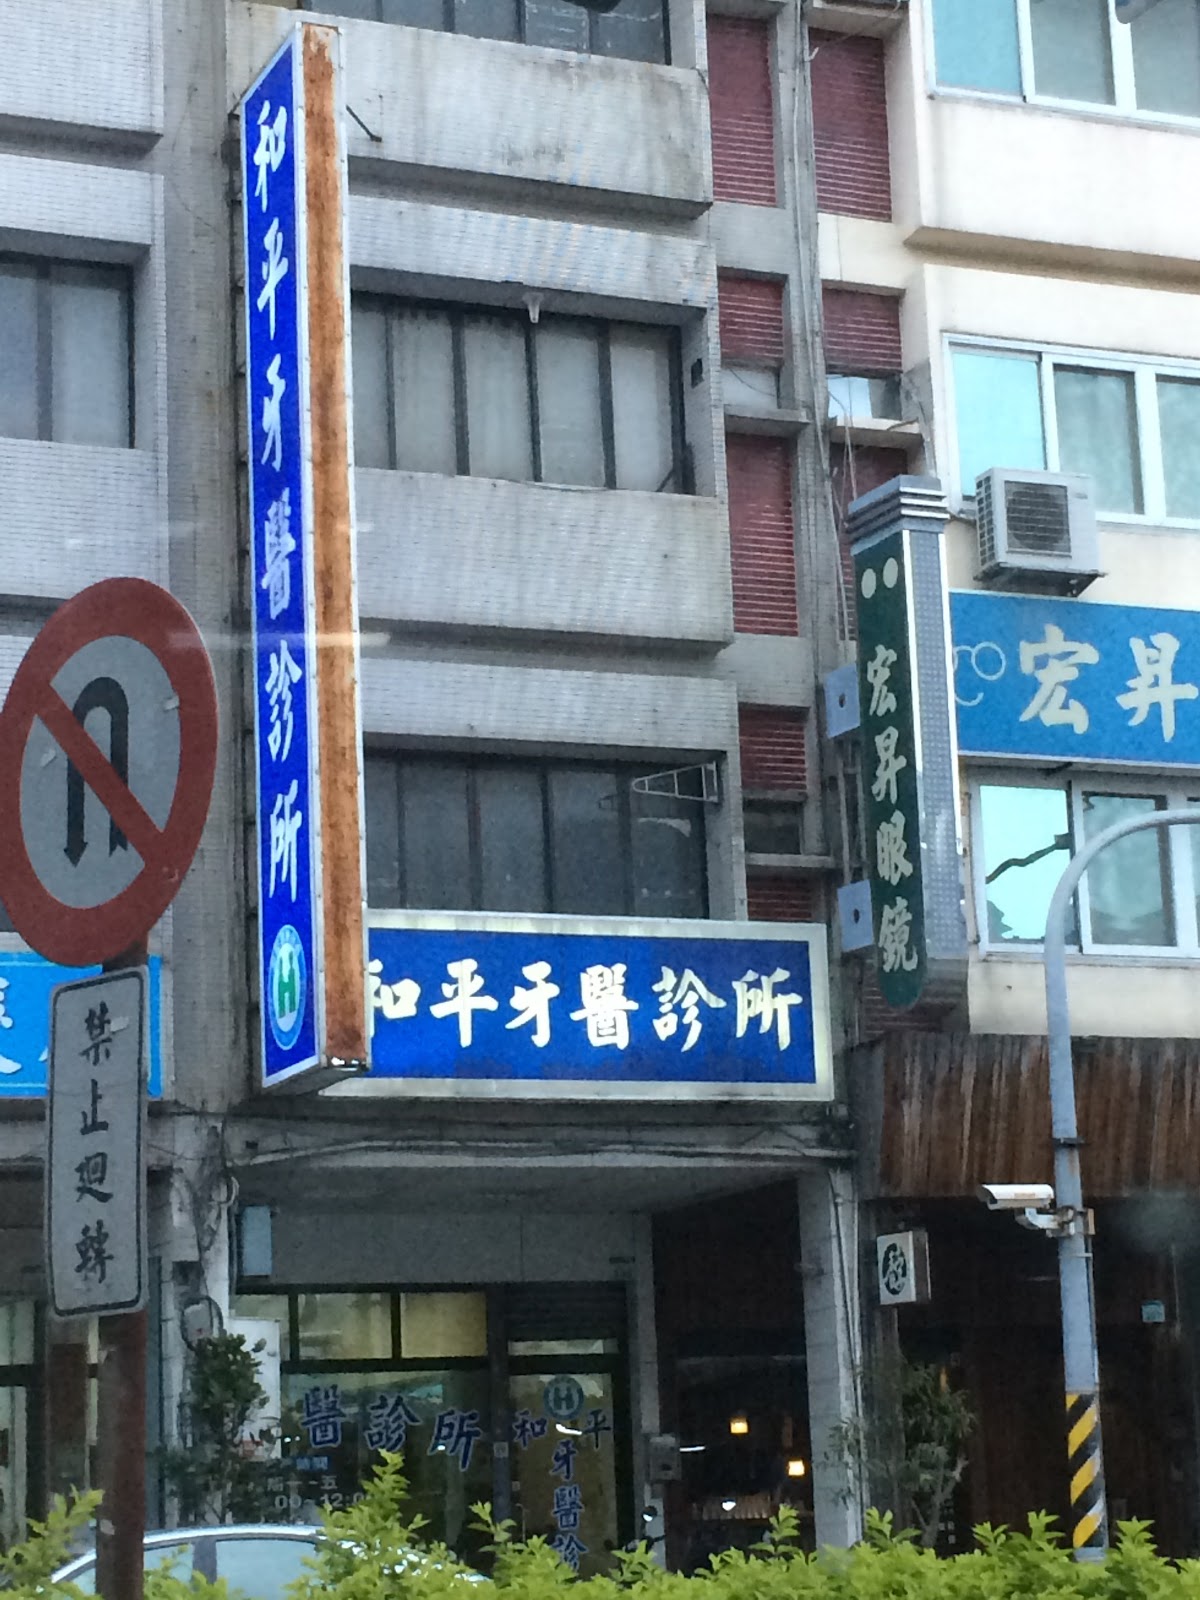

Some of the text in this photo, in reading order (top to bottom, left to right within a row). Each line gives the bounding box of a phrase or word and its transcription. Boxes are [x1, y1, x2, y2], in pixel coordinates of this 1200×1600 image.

[253, 99, 302, 903] 和平牙醫診所
[1018, 622, 1199, 743] 宏昇
[866, 644, 919, 972] 宏昇眼鏡
[368, 957, 803, 1052] 和平牙醫診所
[301, 1384, 482, 1471] 醫診所
